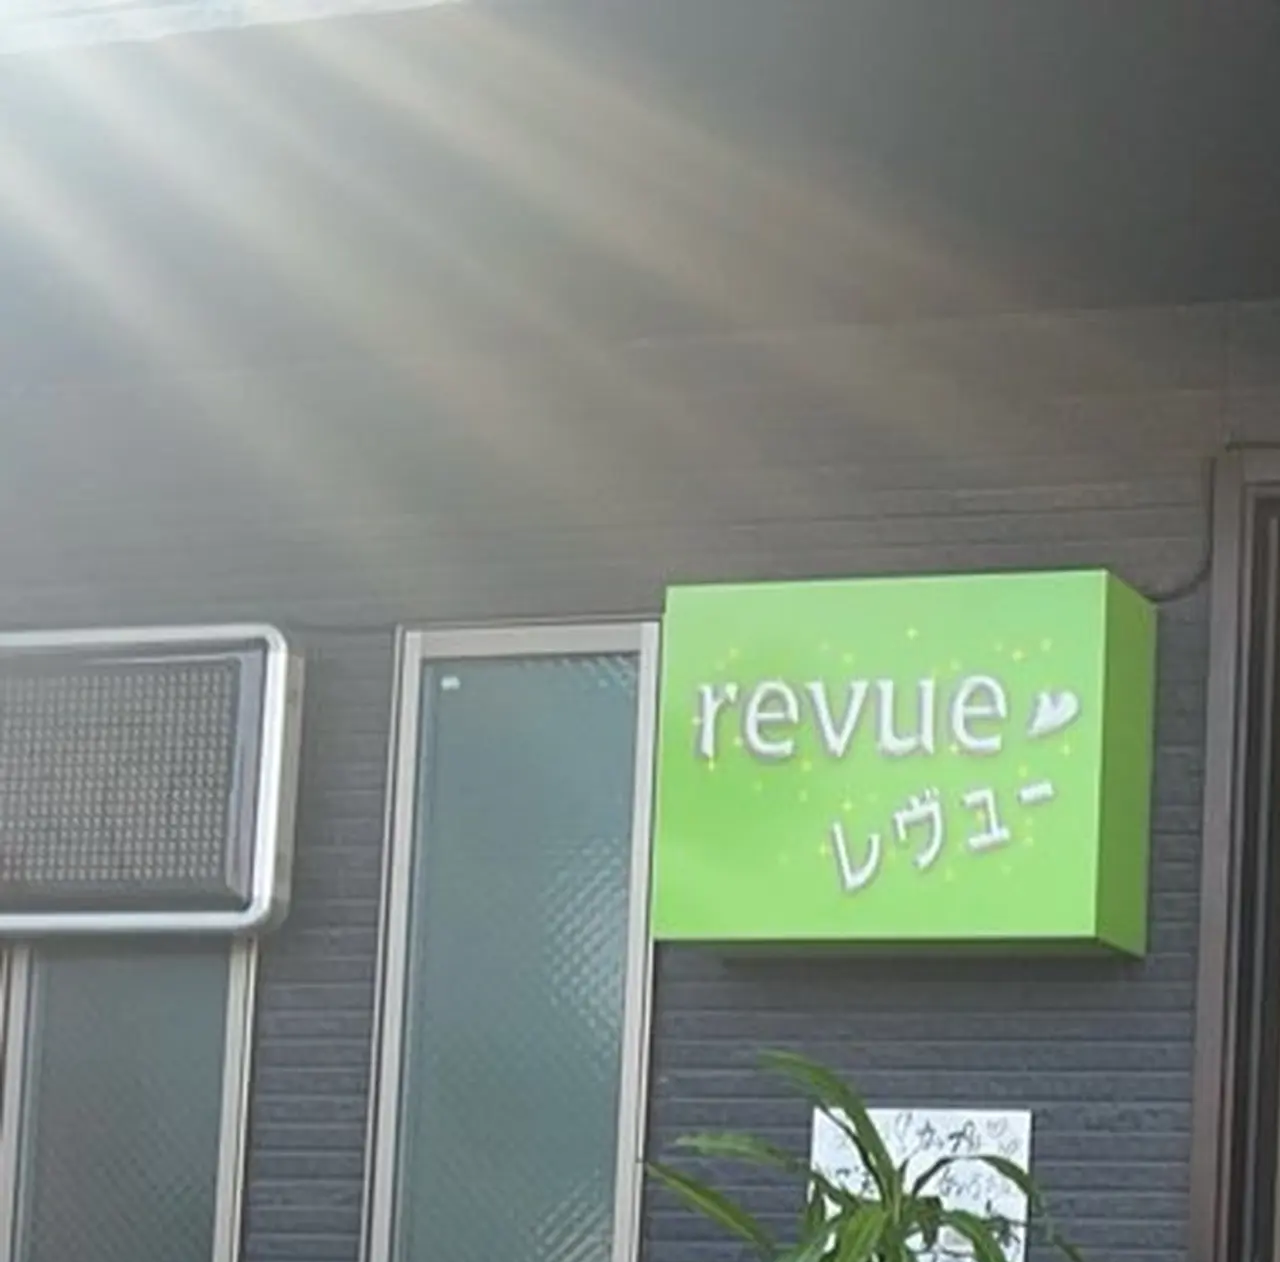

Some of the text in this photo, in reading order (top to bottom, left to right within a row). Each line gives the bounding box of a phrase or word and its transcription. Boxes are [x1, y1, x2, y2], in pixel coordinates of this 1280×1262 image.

[697, 674, 1007, 758] revue
[832, 780, 1054, 891] レヴュー
